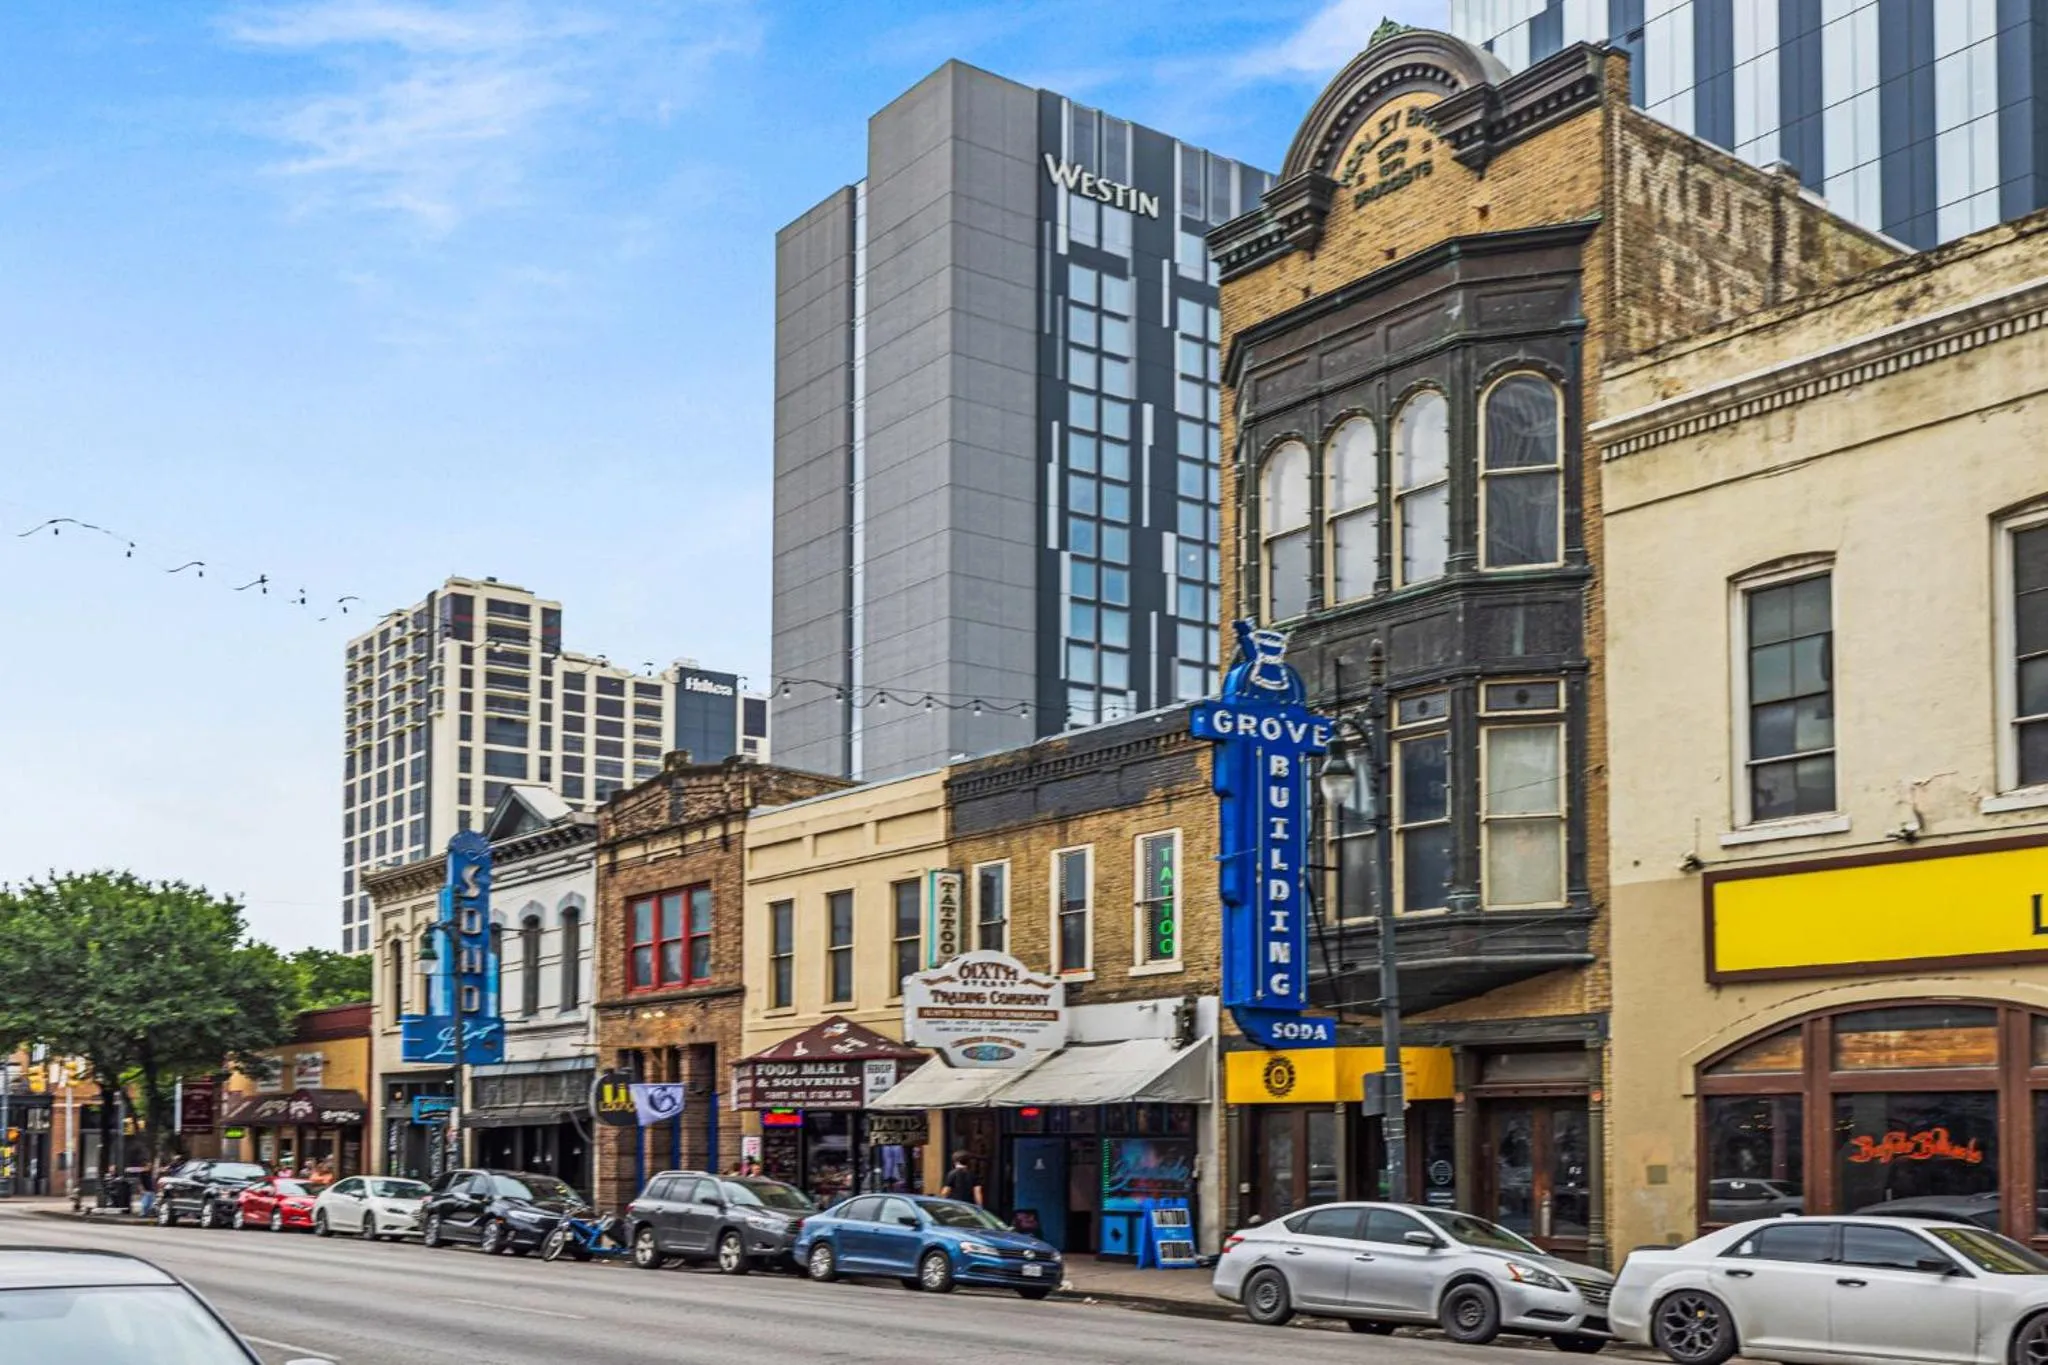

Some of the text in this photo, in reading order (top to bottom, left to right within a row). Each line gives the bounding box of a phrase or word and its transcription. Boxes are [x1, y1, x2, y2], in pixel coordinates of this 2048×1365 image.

[1043, 152, 1160, 219] WESTIN
[1212, 709, 1329, 747] GROVE
[1159, 846, 1176, 955] TATTOO
[1268, 754, 1291, 997] BUILDING
[460, 864, 483, 1013] SOHO
[940, 881, 957, 955] TATTOO
[1272, 1022, 1328, 1041] SODA
[756, 1062, 846, 1076] FOOD MART
[756, 1077, 861, 1088] & SOUVENIRS
